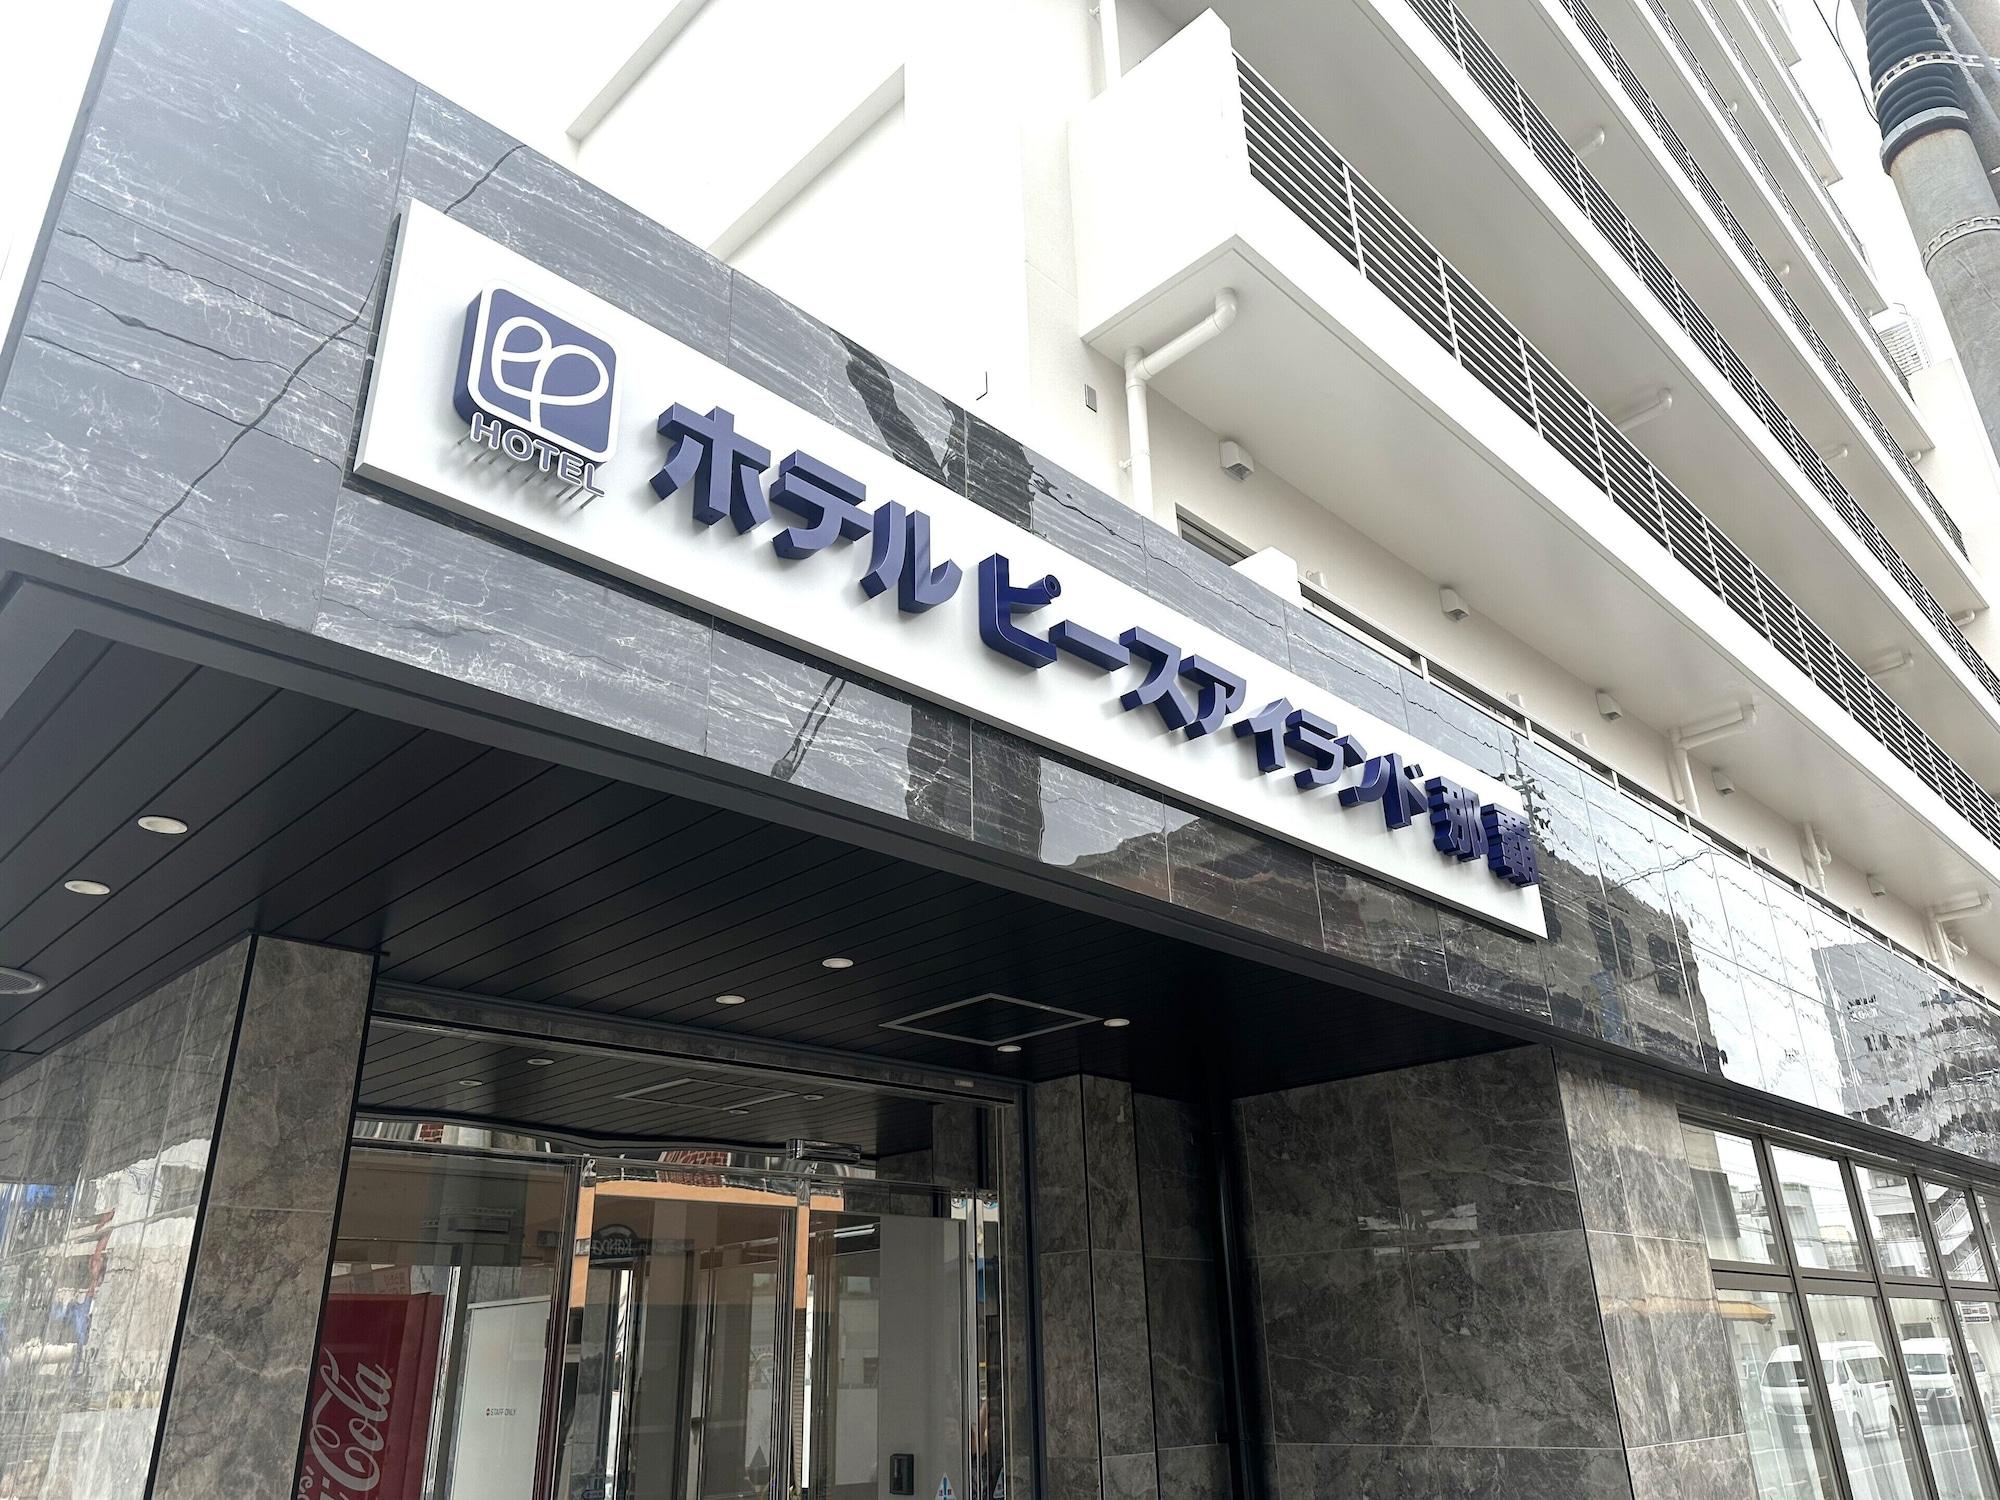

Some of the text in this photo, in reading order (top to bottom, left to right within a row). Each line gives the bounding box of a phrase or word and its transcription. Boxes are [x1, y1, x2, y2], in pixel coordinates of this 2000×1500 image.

[469, 411, 606, 498] HOTEL
[649, 401, 963, 614] ホテル
